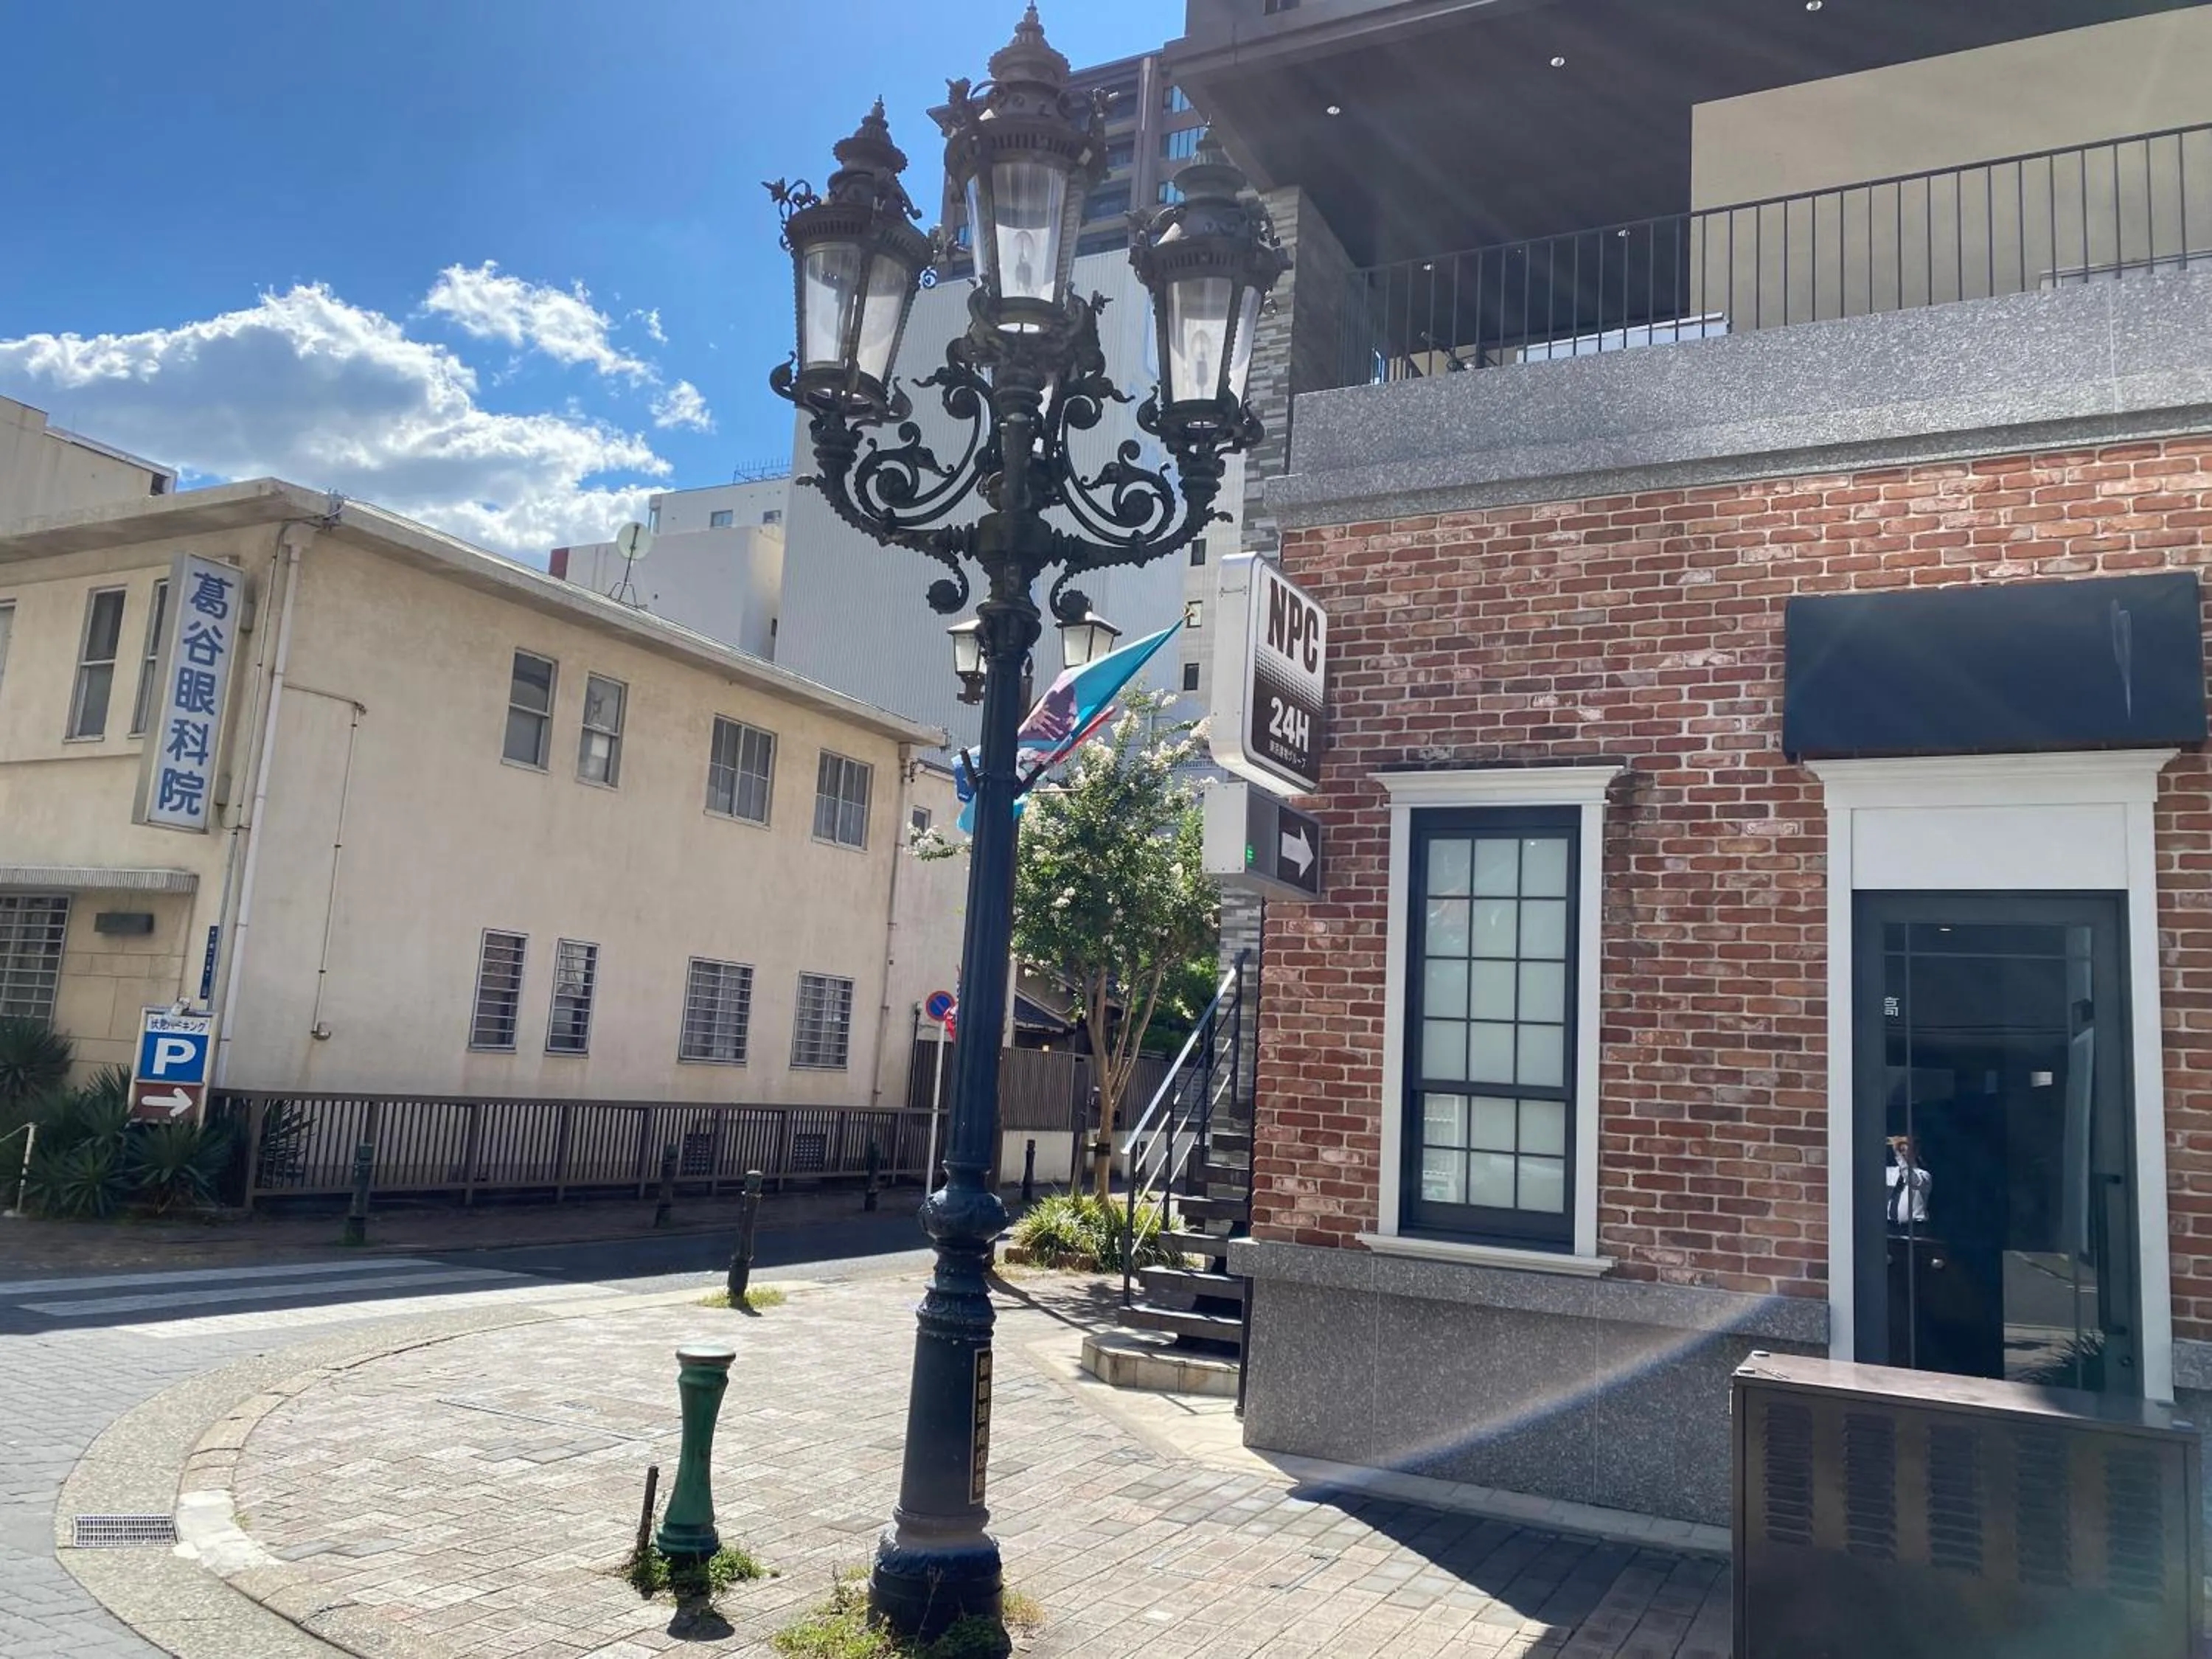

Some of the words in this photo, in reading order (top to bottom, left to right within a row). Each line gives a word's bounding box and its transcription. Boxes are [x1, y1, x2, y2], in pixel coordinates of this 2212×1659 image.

[1268, 577, 1319, 673] NPC
[159, 571, 233, 815] 葛谷眼科院
[1269, 697, 1310, 752] 24H
[153, 1038, 197, 1074] P
